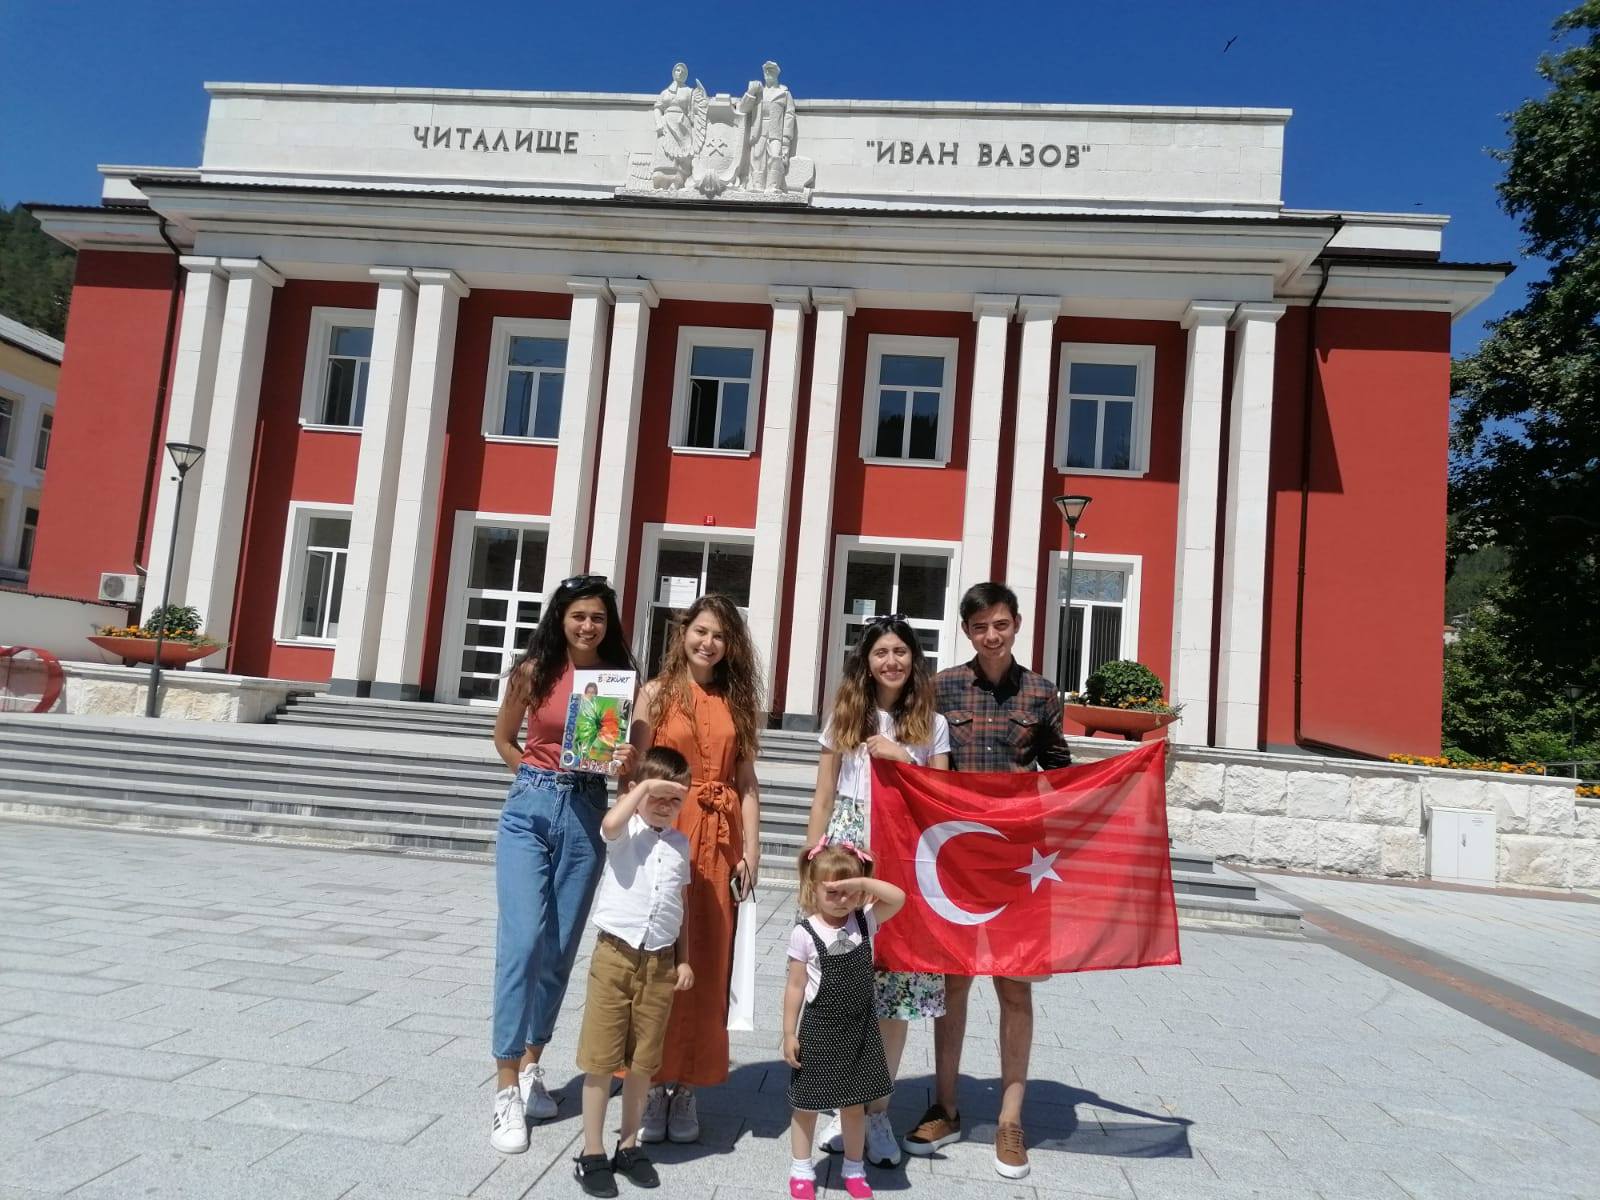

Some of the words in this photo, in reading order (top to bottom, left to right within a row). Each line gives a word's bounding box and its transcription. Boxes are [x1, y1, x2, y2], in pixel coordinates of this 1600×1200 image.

[413, 126, 579, 154] ЧИТАЛИЩЕ
[866, 140, 959, 166] "ИВАН
[977, 143, 1091, 168] ВАЗОВ"
